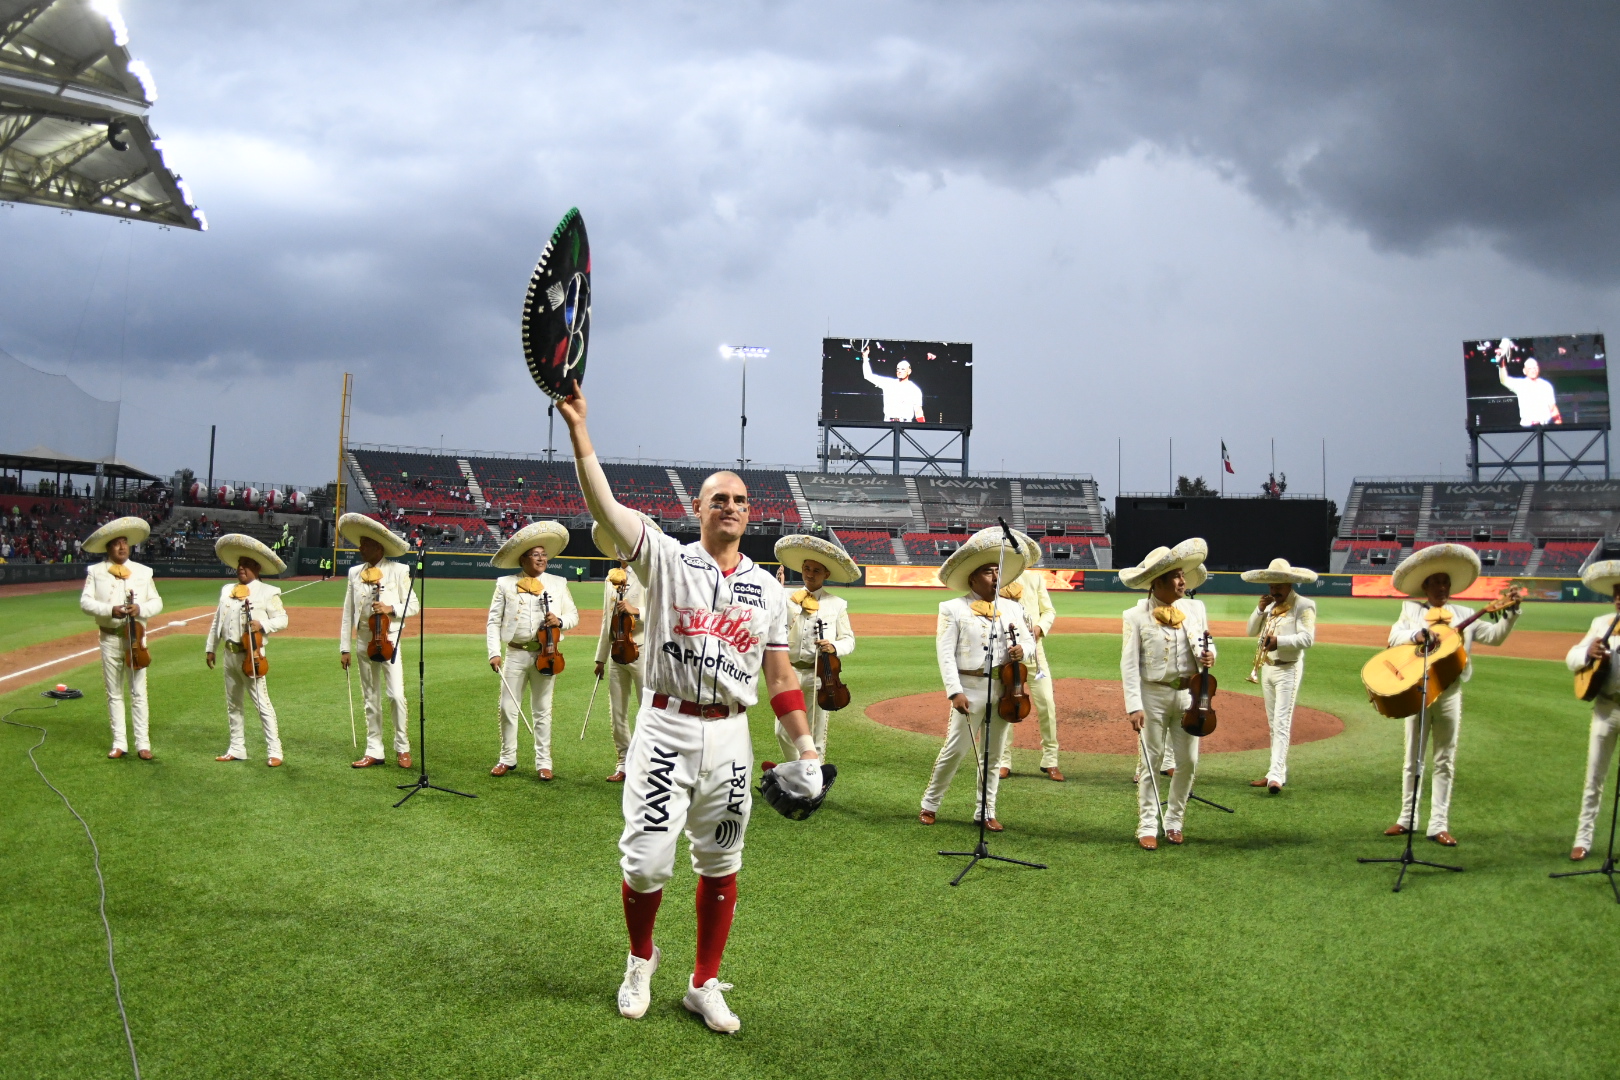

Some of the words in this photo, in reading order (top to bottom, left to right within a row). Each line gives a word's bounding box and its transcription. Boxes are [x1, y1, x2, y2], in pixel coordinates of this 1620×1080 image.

[809, 476, 845, 485] Red
[847, 476, 889, 486] Cola
[929, 478, 998, 490] KAVAK
[1446, 484, 1511, 494] KAVAK
[734, 584, 762, 595] codere
[672, 602, 760, 654] Diablos
[643, 746, 679, 832] KAVAK
[727, 760, 746, 816] AT&T
